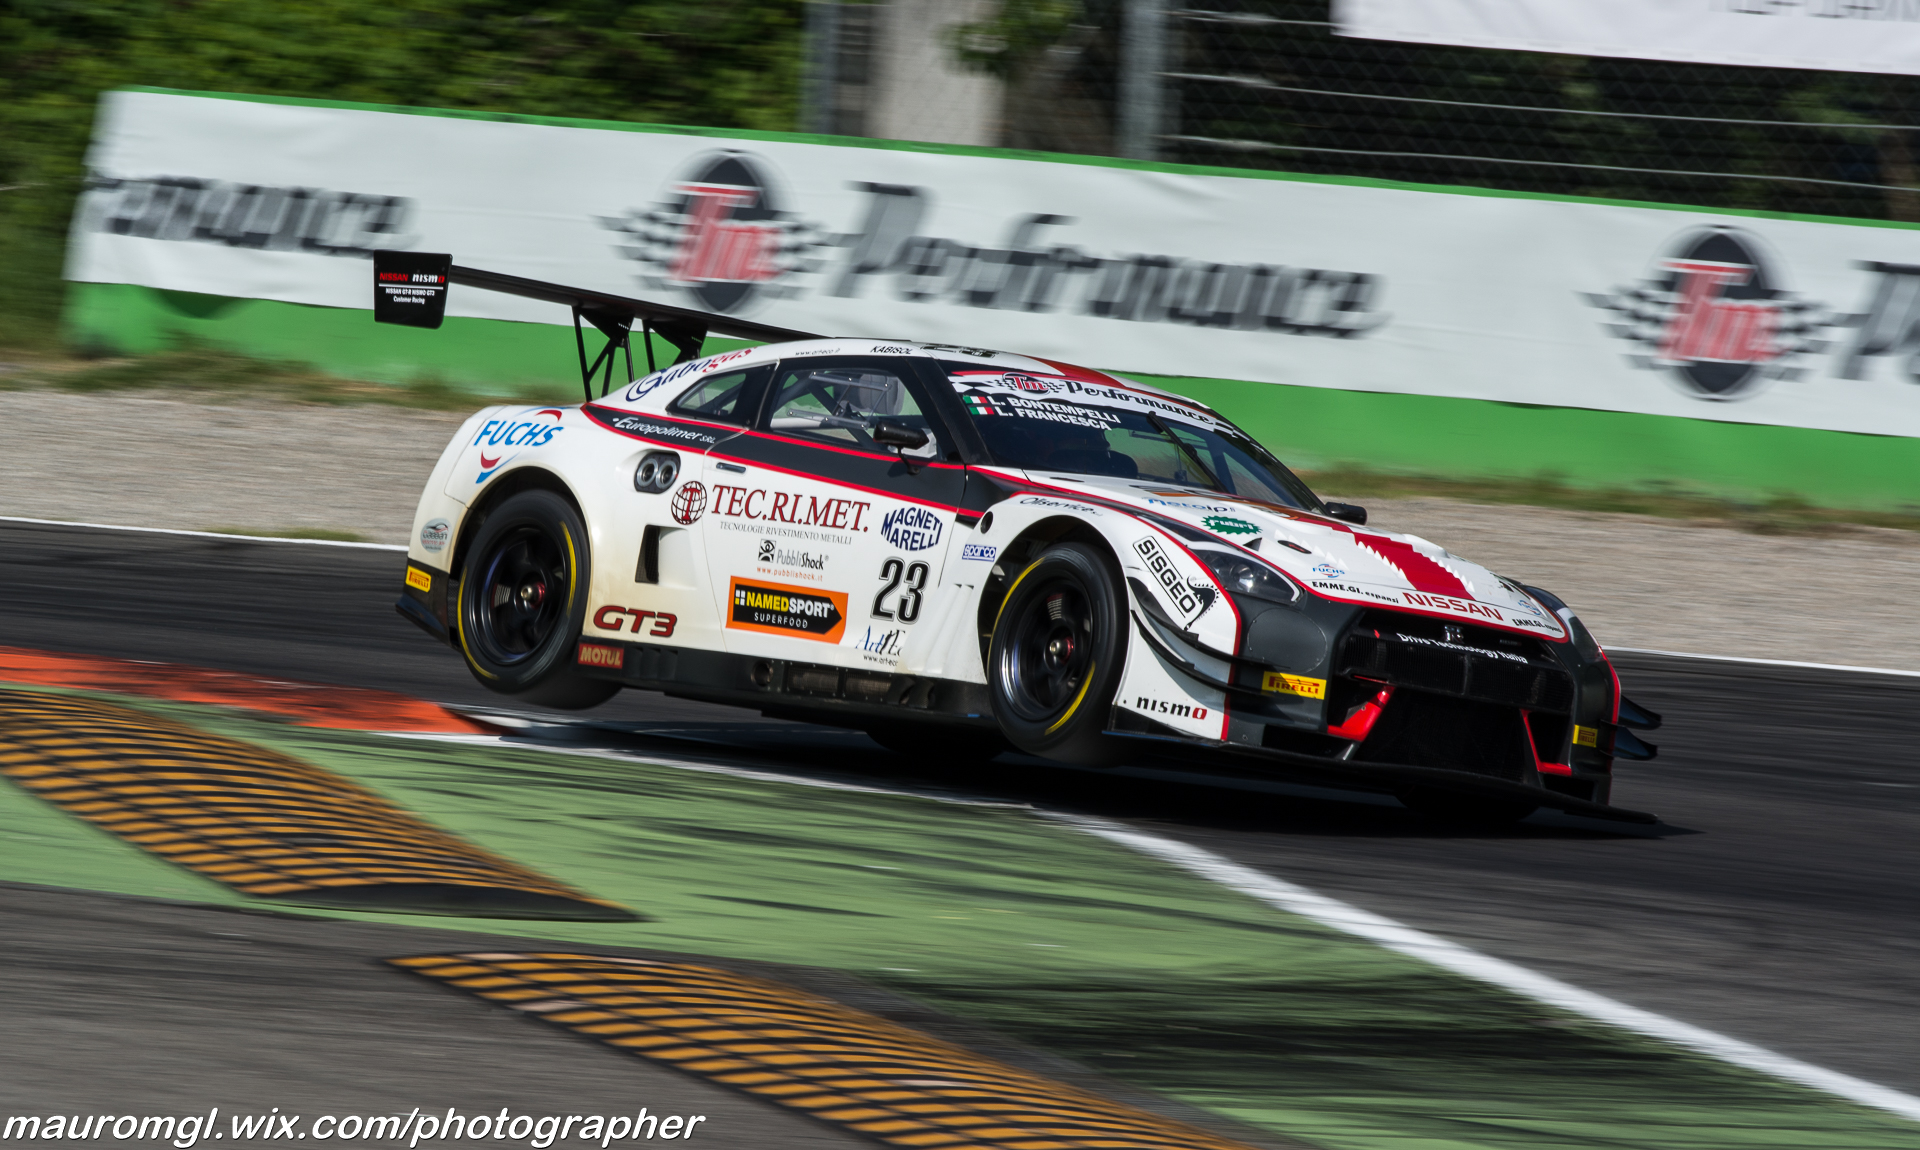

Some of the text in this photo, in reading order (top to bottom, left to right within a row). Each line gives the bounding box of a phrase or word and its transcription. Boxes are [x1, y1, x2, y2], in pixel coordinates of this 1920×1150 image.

[379, 272, 409, 282] NISSAN
[385, 287, 402, 296] NISSAN
[412, 289, 426, 297] NISMO
[427, 289, 435, 297] GT3
[393, 295, 425, 305] Customer Racing
[869, 345, 913, 355] KABISOL
[987, 396, 1122, 425] L. BONTEMPELLI
[1063, 379, 1214, 425] Performance
[614, 416, 702, 440] Europolimer
[994, 405, 1113, 432] L. FRANCESCA
[473, 420, 565, 447] FUCHS
[711, 484, 872, 533] TEC.RI.MET.
[719, 521, 853, 546] TECNOLOGIE RIVESTIMENTO METALLI
[881, 507, 944, 541] MAGNETI
[964, 545, 997, 559] sparco
[408, 571, 430, 589] PIRELLI
[756, 567, 824, 583] www.pubblishock.it
[1137, 539, 1197, 615] SISGEO
[870, 556, 931, 626] 23
[746, 591, 831, 618] NAMEDSPORT
[1402, 591, 1505, 623] NISSAN
[593, 604, 678, 638] GT3
[754, 611, 809, 629] SUPERFOOD
[1396, 632, 1432, 646] Drive
[580, 646, 622, 667] MOTUL
[1268, 676, 1320, 695] PIRELLI
[1136, 696, 1208, 720] nismo
